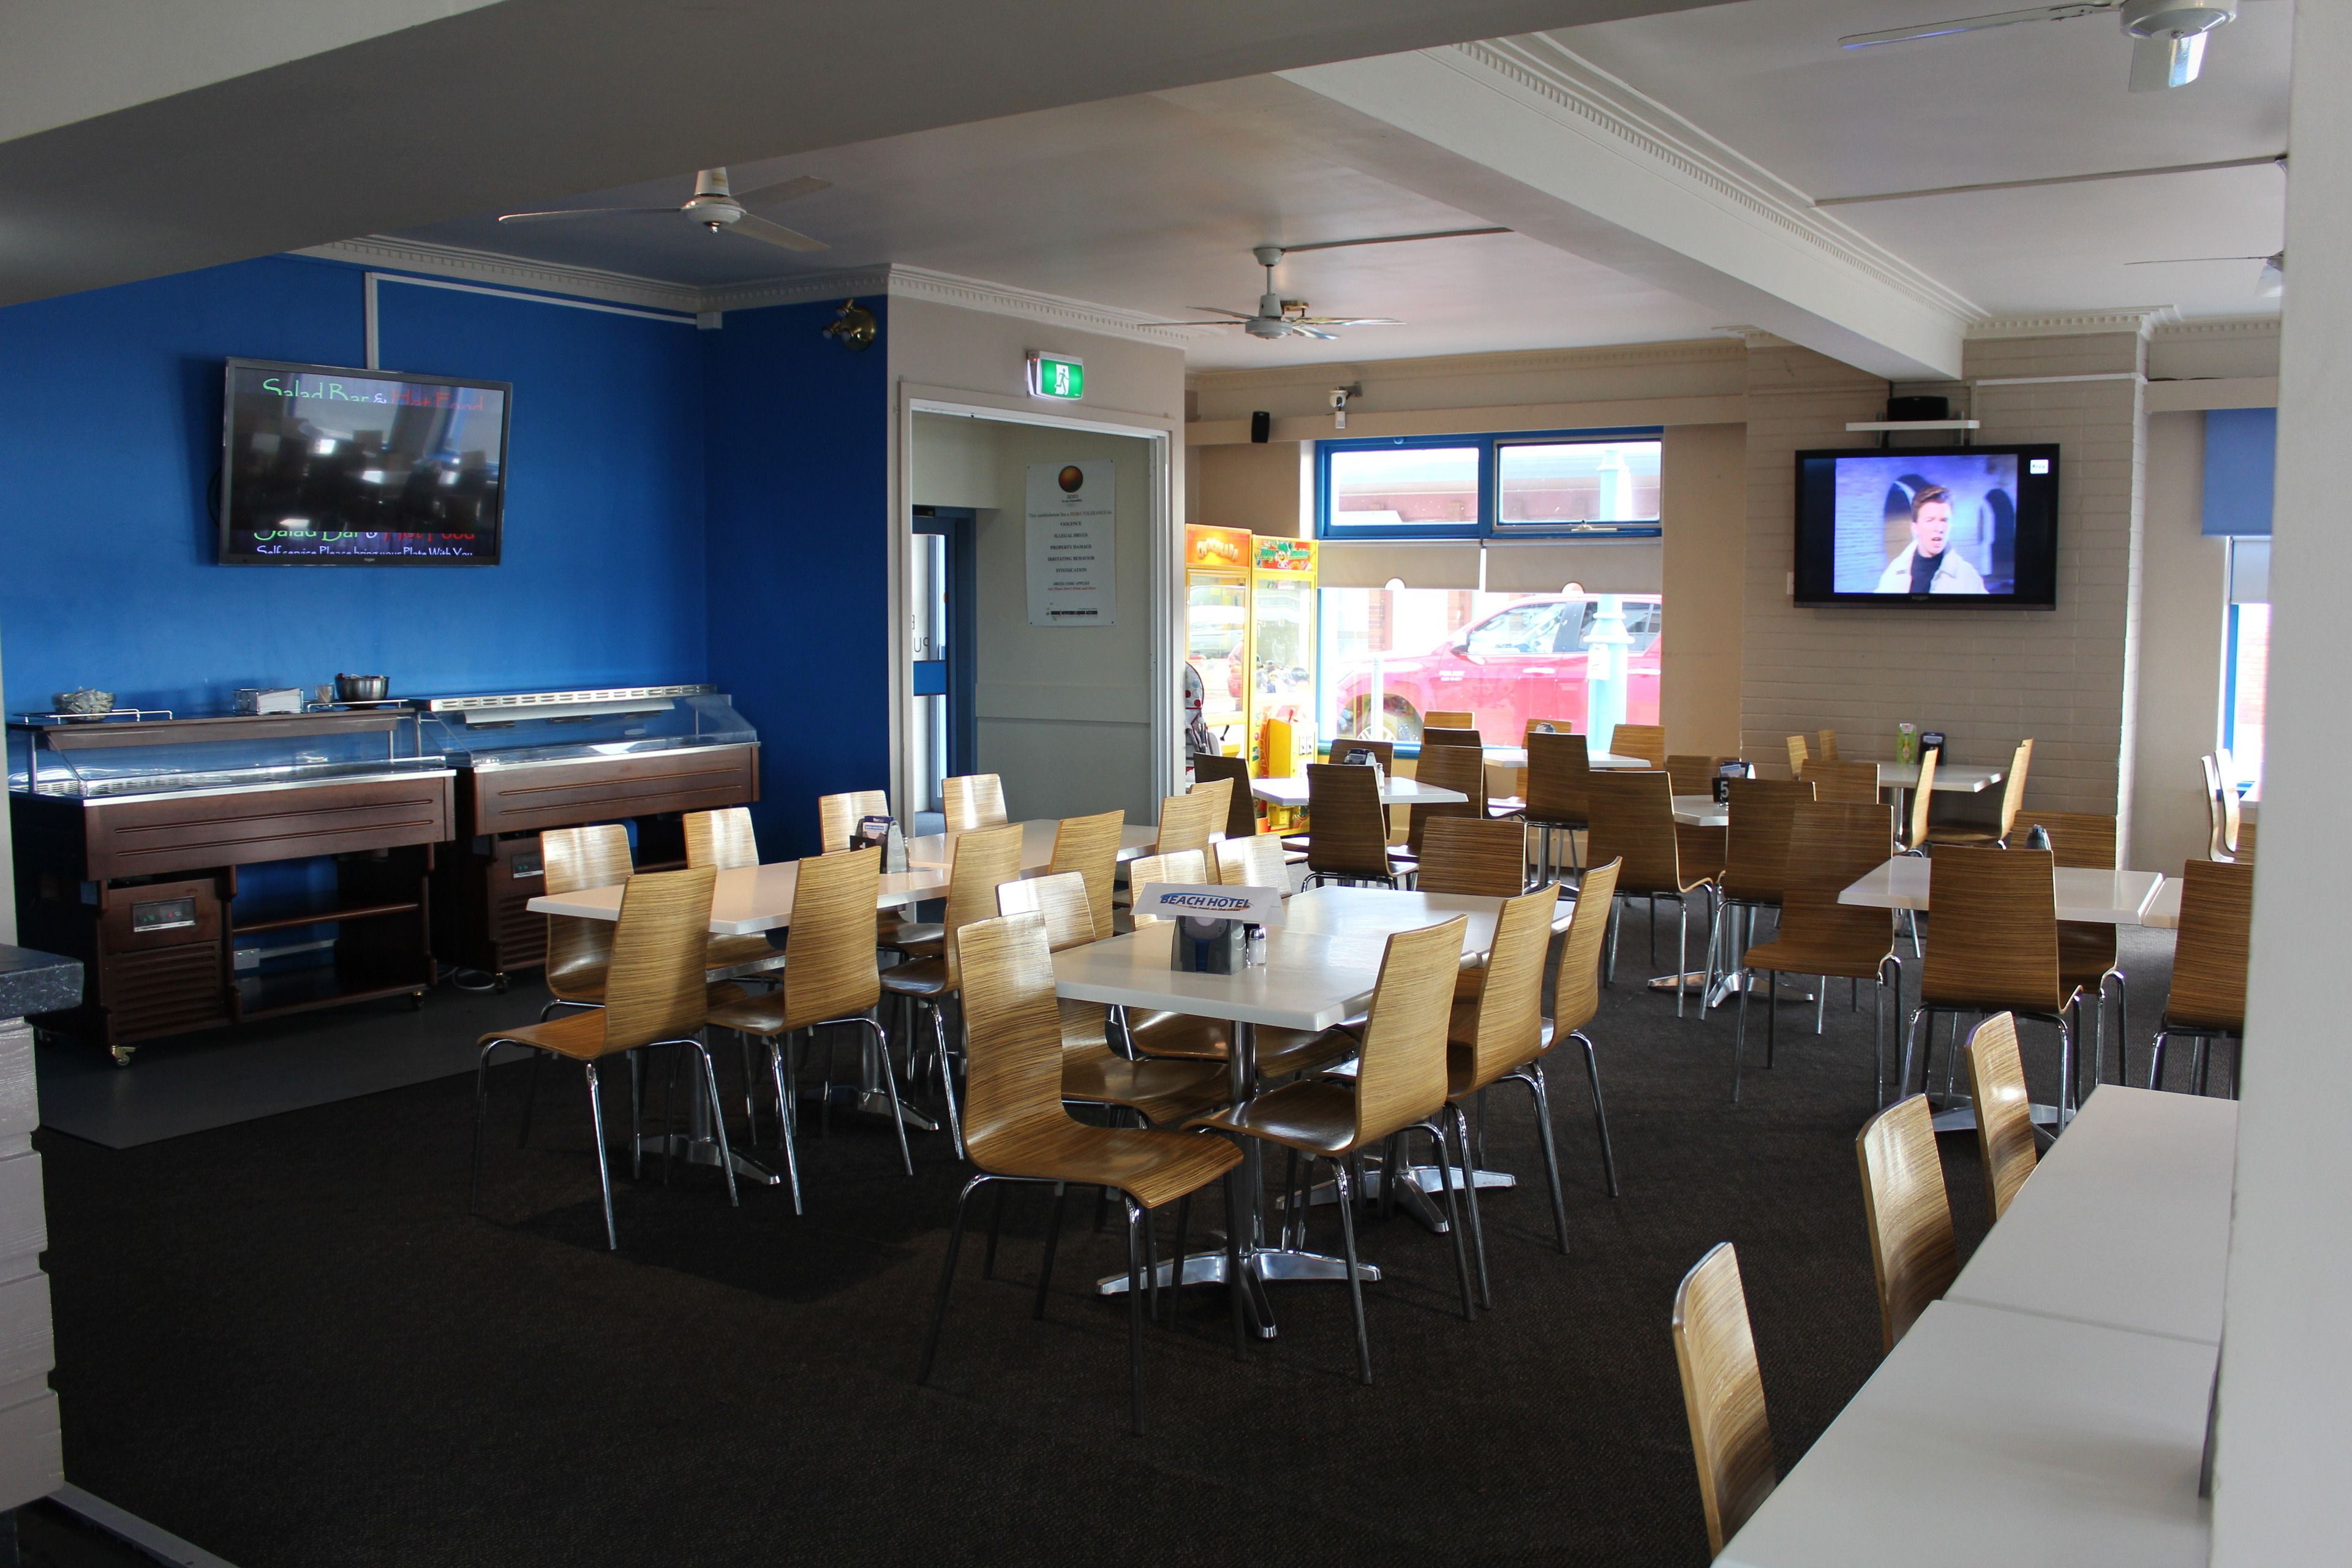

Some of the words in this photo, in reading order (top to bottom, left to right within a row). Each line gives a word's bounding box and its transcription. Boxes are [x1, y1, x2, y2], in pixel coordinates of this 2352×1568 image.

[1720, 780, 1730, 798] 5
[1159, 895, 1206, 906] BEACH
[1207, 898, 1250, 908] HOTEL
